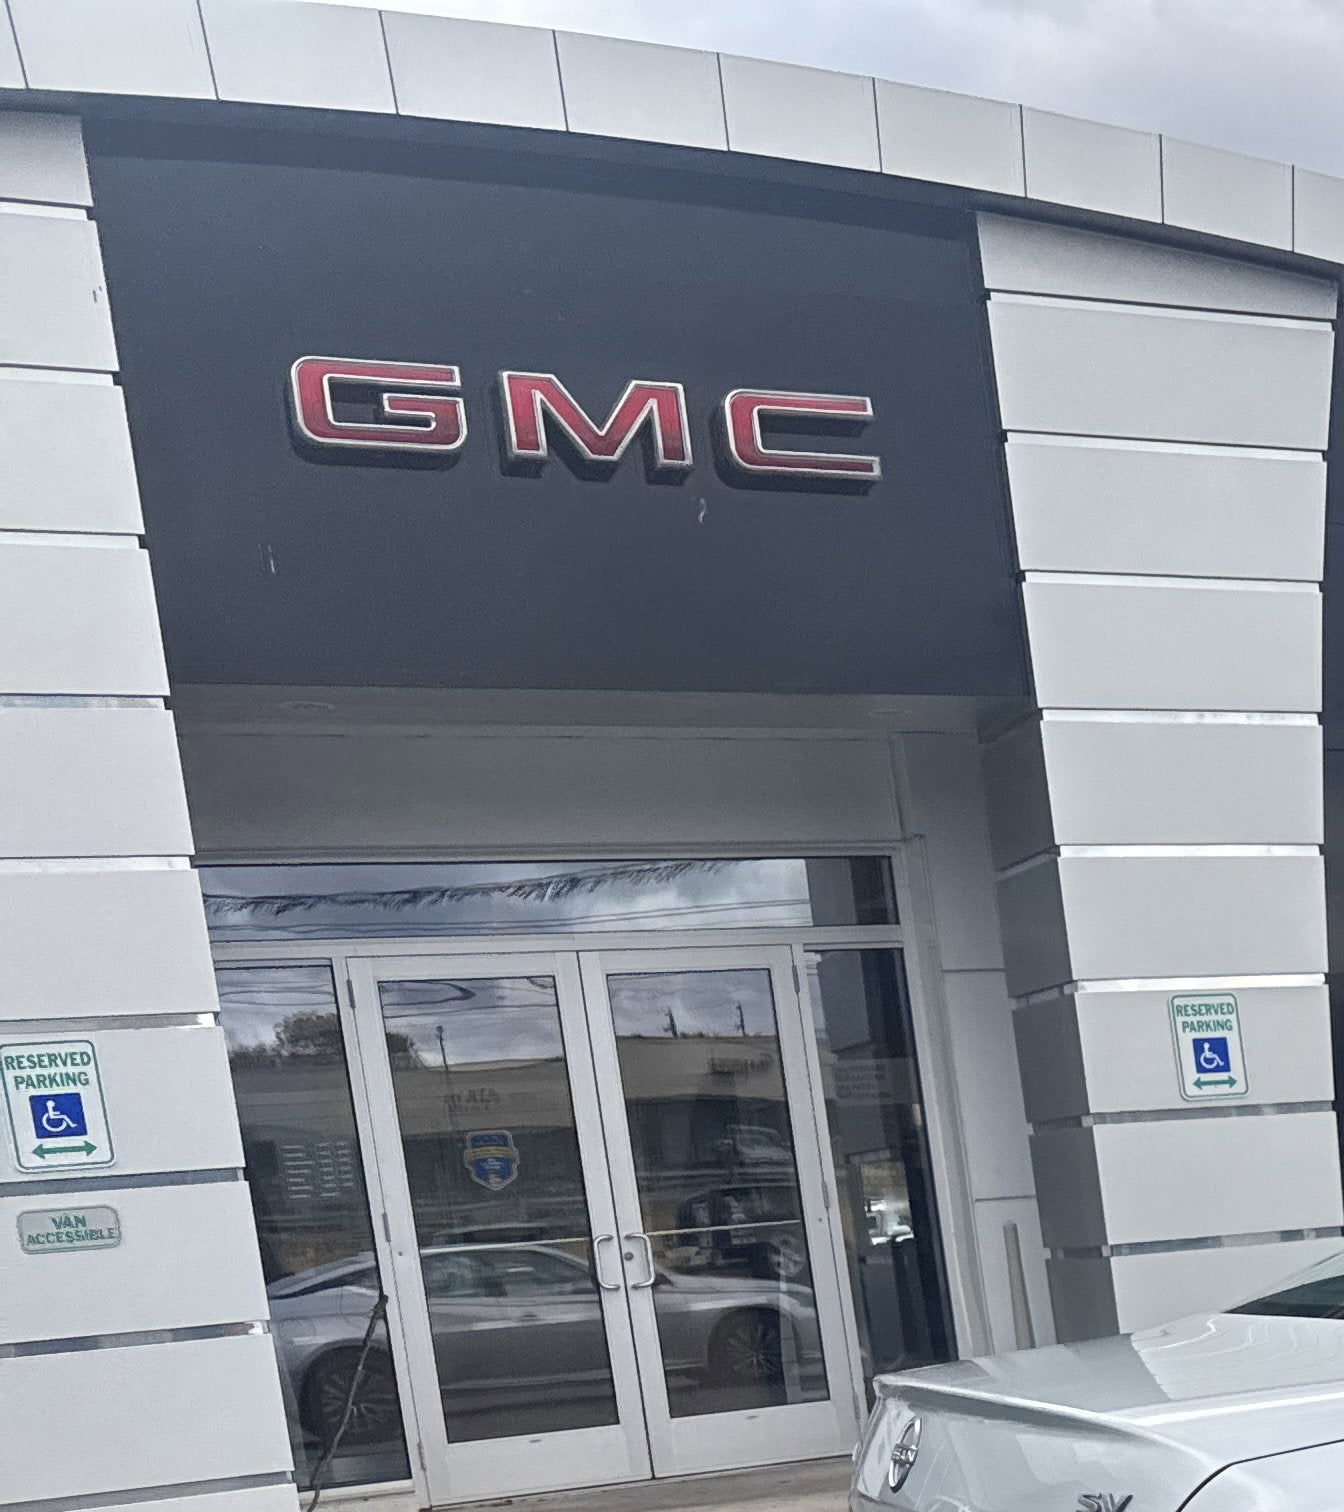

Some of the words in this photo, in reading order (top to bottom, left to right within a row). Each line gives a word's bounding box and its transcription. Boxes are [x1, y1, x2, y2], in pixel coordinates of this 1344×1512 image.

[291, 355, 882, 480] GMC
[1176, 1003, 1235, 1018] RESERVED
[1182, 1019, 1233, 1034] PARKING
[4, 1051, 92, 1071] RESERVED
[14, 1071, 90, 1091] PARKING
[52, 1215, 87, 1231] VAN
